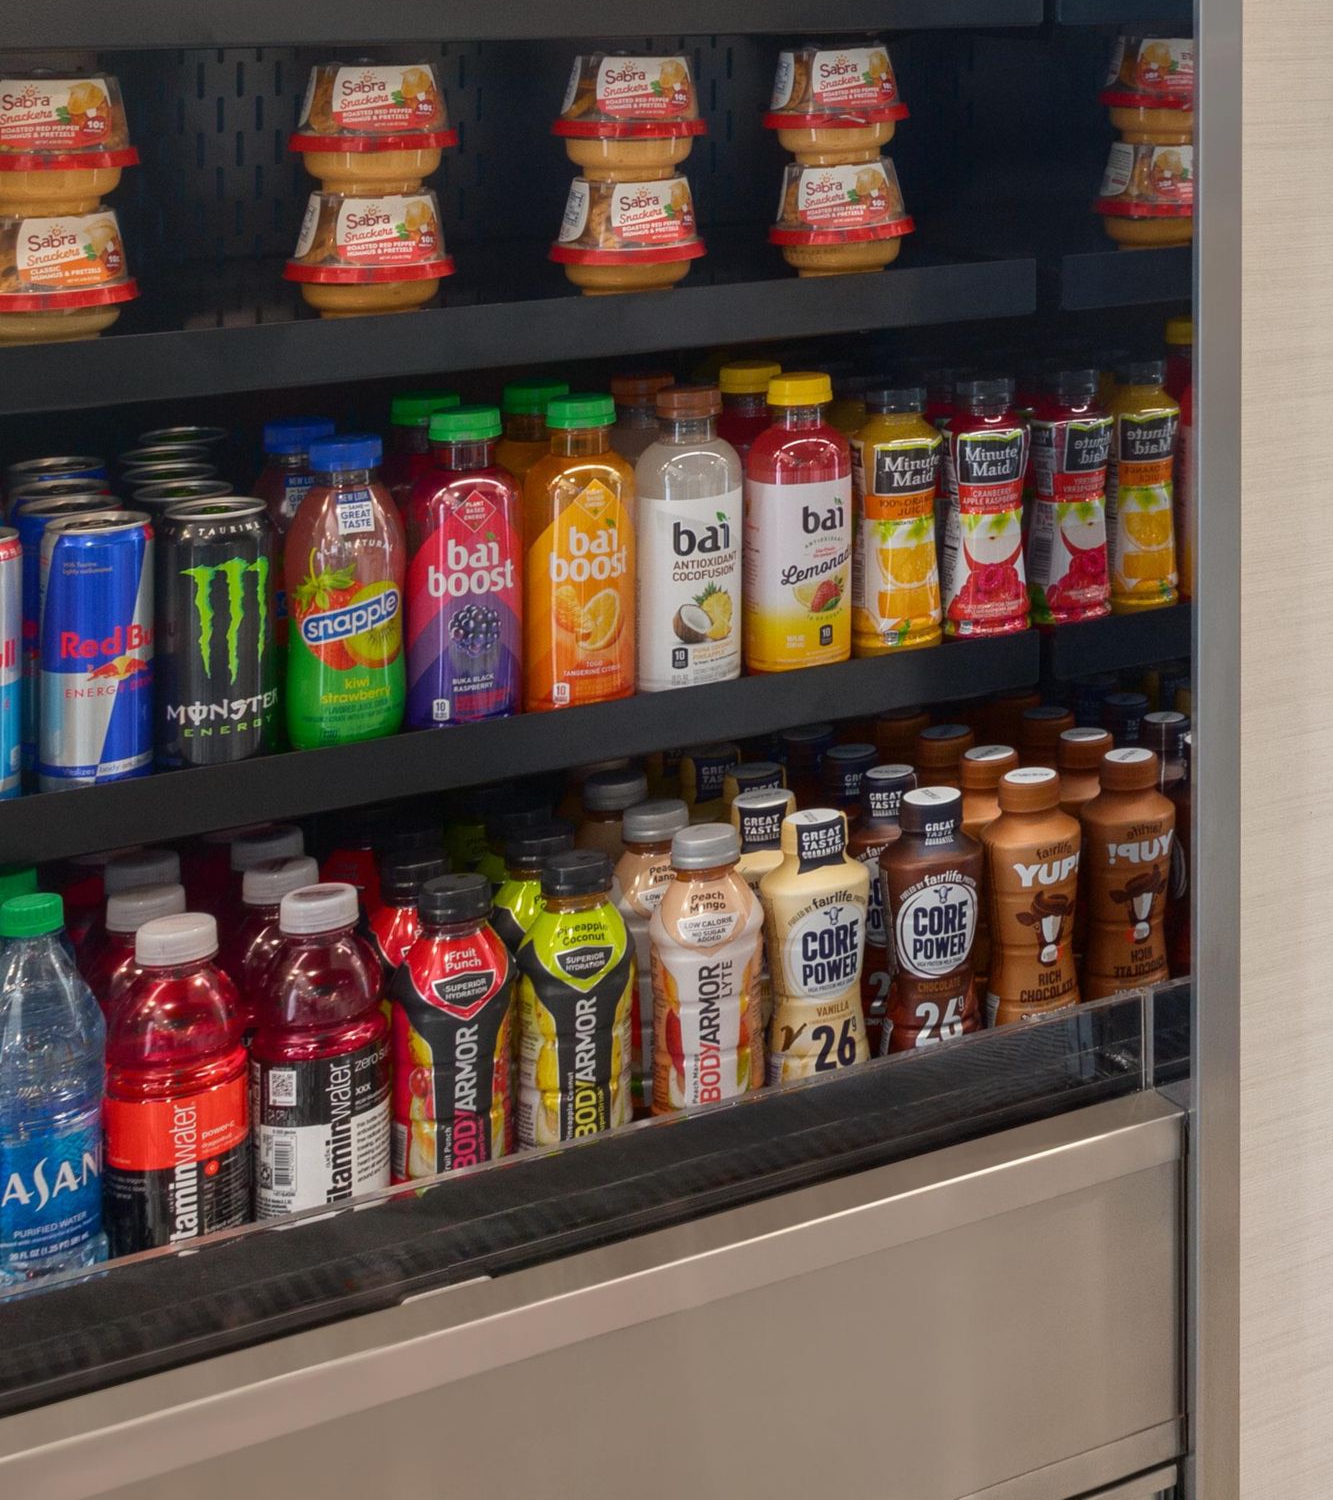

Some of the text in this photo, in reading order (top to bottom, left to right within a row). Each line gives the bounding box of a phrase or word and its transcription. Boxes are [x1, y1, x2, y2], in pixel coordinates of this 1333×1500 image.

[605, 69, 646, 85] Sabra
[820, 63, 858, 78] Sabra
[342, 81, 386, 97] Sabra
[603, 82, 648, 97] Snackers
[819, 75, 861, 90] Snackers
[2, 94, 50, 111] Sabra
[340, 94, 389, 110] Snackers
[0, 111, 52, 126] Snackers
[806, 181, 844, 197] Sabra
[619, 196, 660, 212] Sabra
[804, 193, 845, 208] Snackers
[346, 213, 390, 230] Sabra
[619, 209, 662, 224] Snackers
[27, 234, 77, 252] Sabra
[344, 227, 393, 243] Snackers
[27, 249, 80, 267] Snackers
[965, 447, 1018, 462] Minute
[884, 455, 940, 472] Minute
[972, 461, 1010, 477] Maid
[892, 468, 934, 487] Maid
[972, 487, 1012, 498] CRANBERRY
[341, 509, 371, 520] GREAT
[802, 505, 844, 534] bai
[342, 518, 371, 529] TASTE
[569, 524, 618, 555] bai
[673, 521, 730, 556] bai
[447, 536, 499, 570] bai
[673, 551, 737, 570] ANTIOXIDANT
[550, 546, 627, 582] boost
[428, 558, 514, 597] boost
[672, 566, 735, 581] COCOFUSION
[307, 592, 398, 640] snapple
[60, 626, 121, 659] Red
[345, 676, 369, 688] kiwi
[453, 682, 493, 692] RASPBERRY
[320, 685, 391, 704] strawberry
[167, 688, 279, 725] MONSTER
[184, 715, 271, 737] ENERGY
[868, 791, 902, 805] GREAT
[743, 813, 780, 828] GREAT
[925, 819, 955, 832] GREAT
[744, 823, 781, 837] TASTE
[802, 825, 841, 842] GREAT
[803, 836, 842, 851] TASTE
[1036, 842, 1073, 861] fairlife
[924, 870, 963, 887] fairlife
[690, 891, 724, 905] Peach
[812, 890, 853, 911] fairlife
[690, 900, 726, 913] Mango
[701, 915, 733, 927] CALORIE
[913, 900, 968, 937] CORE
[557, 921, 607, 938] Pineapple
[563, 932, 605, 947] Coconut
[802, 918, 859, 962] CORE
[912, 932, 966, 960] POWER
[446, 948, 476, 963] Fruit
[566, 952, 605, 965] SUPERIOR
[446, 957, 481, 973] Punch
[566, 960, 605, 972] HYDRATION
[802, 954, 857, 987] POWER
[445, 978, 486, 993] SUPERIOR
[722, 960, 733, 999] LYTE
[917, 978, 961, 993] CHOCOLATE
[1038, 970, 1062, 987] RICH
[446, 986, 488, 1000] HYDRATION
[1020, 978, 1075, 1004] CHOCOLATE
[816, 1000, 849, 1017] VANILLA
[699, 962, 721, 1104] BODYARMOR
[14, 1221, 58, 1238] PURIFIED
